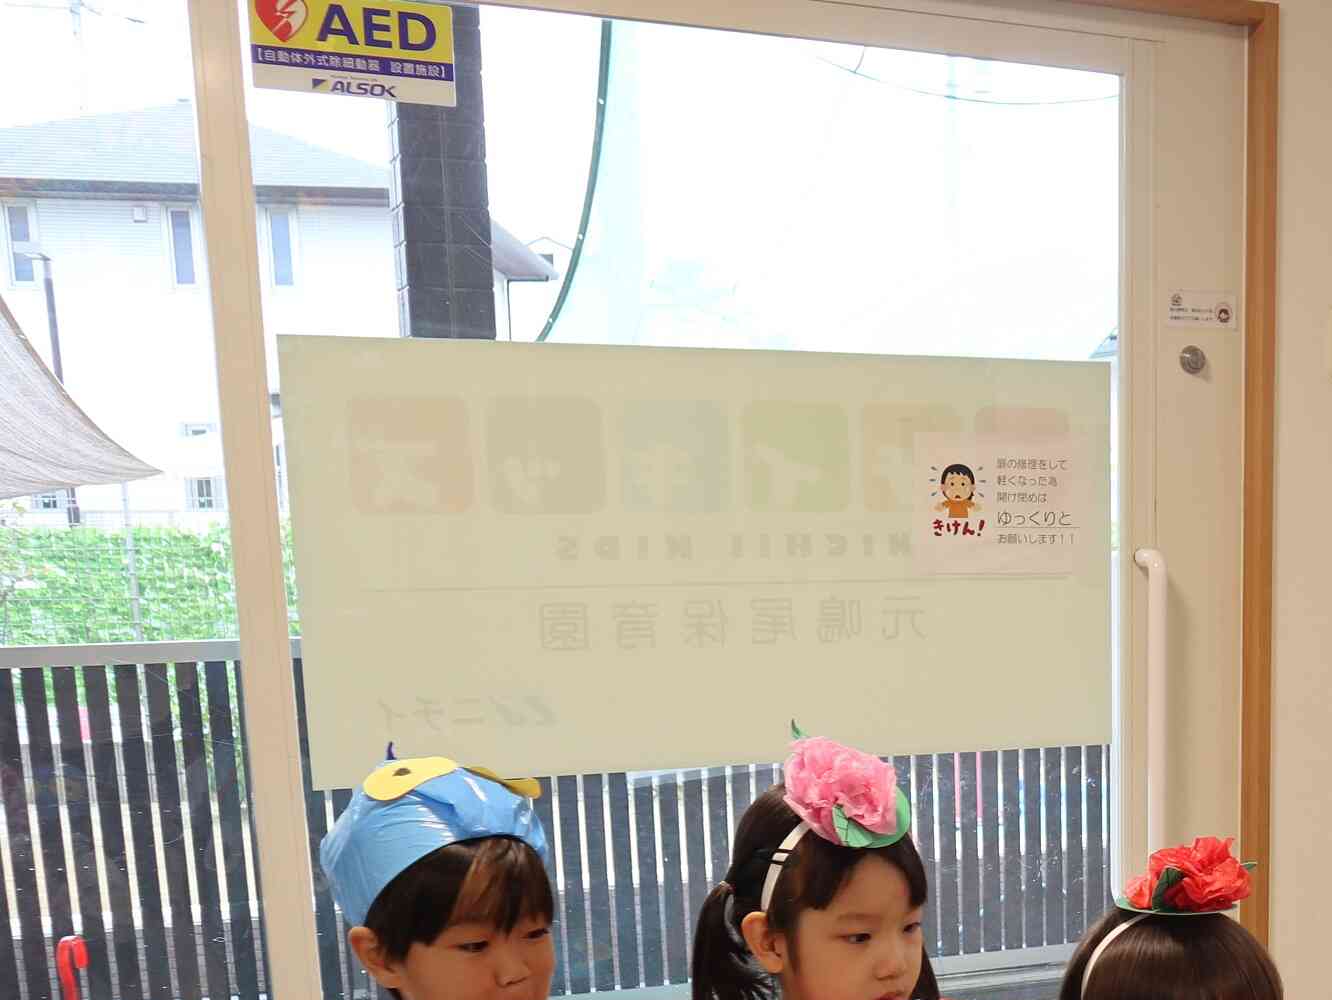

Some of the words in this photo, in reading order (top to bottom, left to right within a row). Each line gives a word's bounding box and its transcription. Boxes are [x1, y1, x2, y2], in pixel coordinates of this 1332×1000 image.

[317, 3, 437, 51] AED
[330, 80, 397, 98] ALSOK
[997, 511, 1073, 526] ゆっくりと
